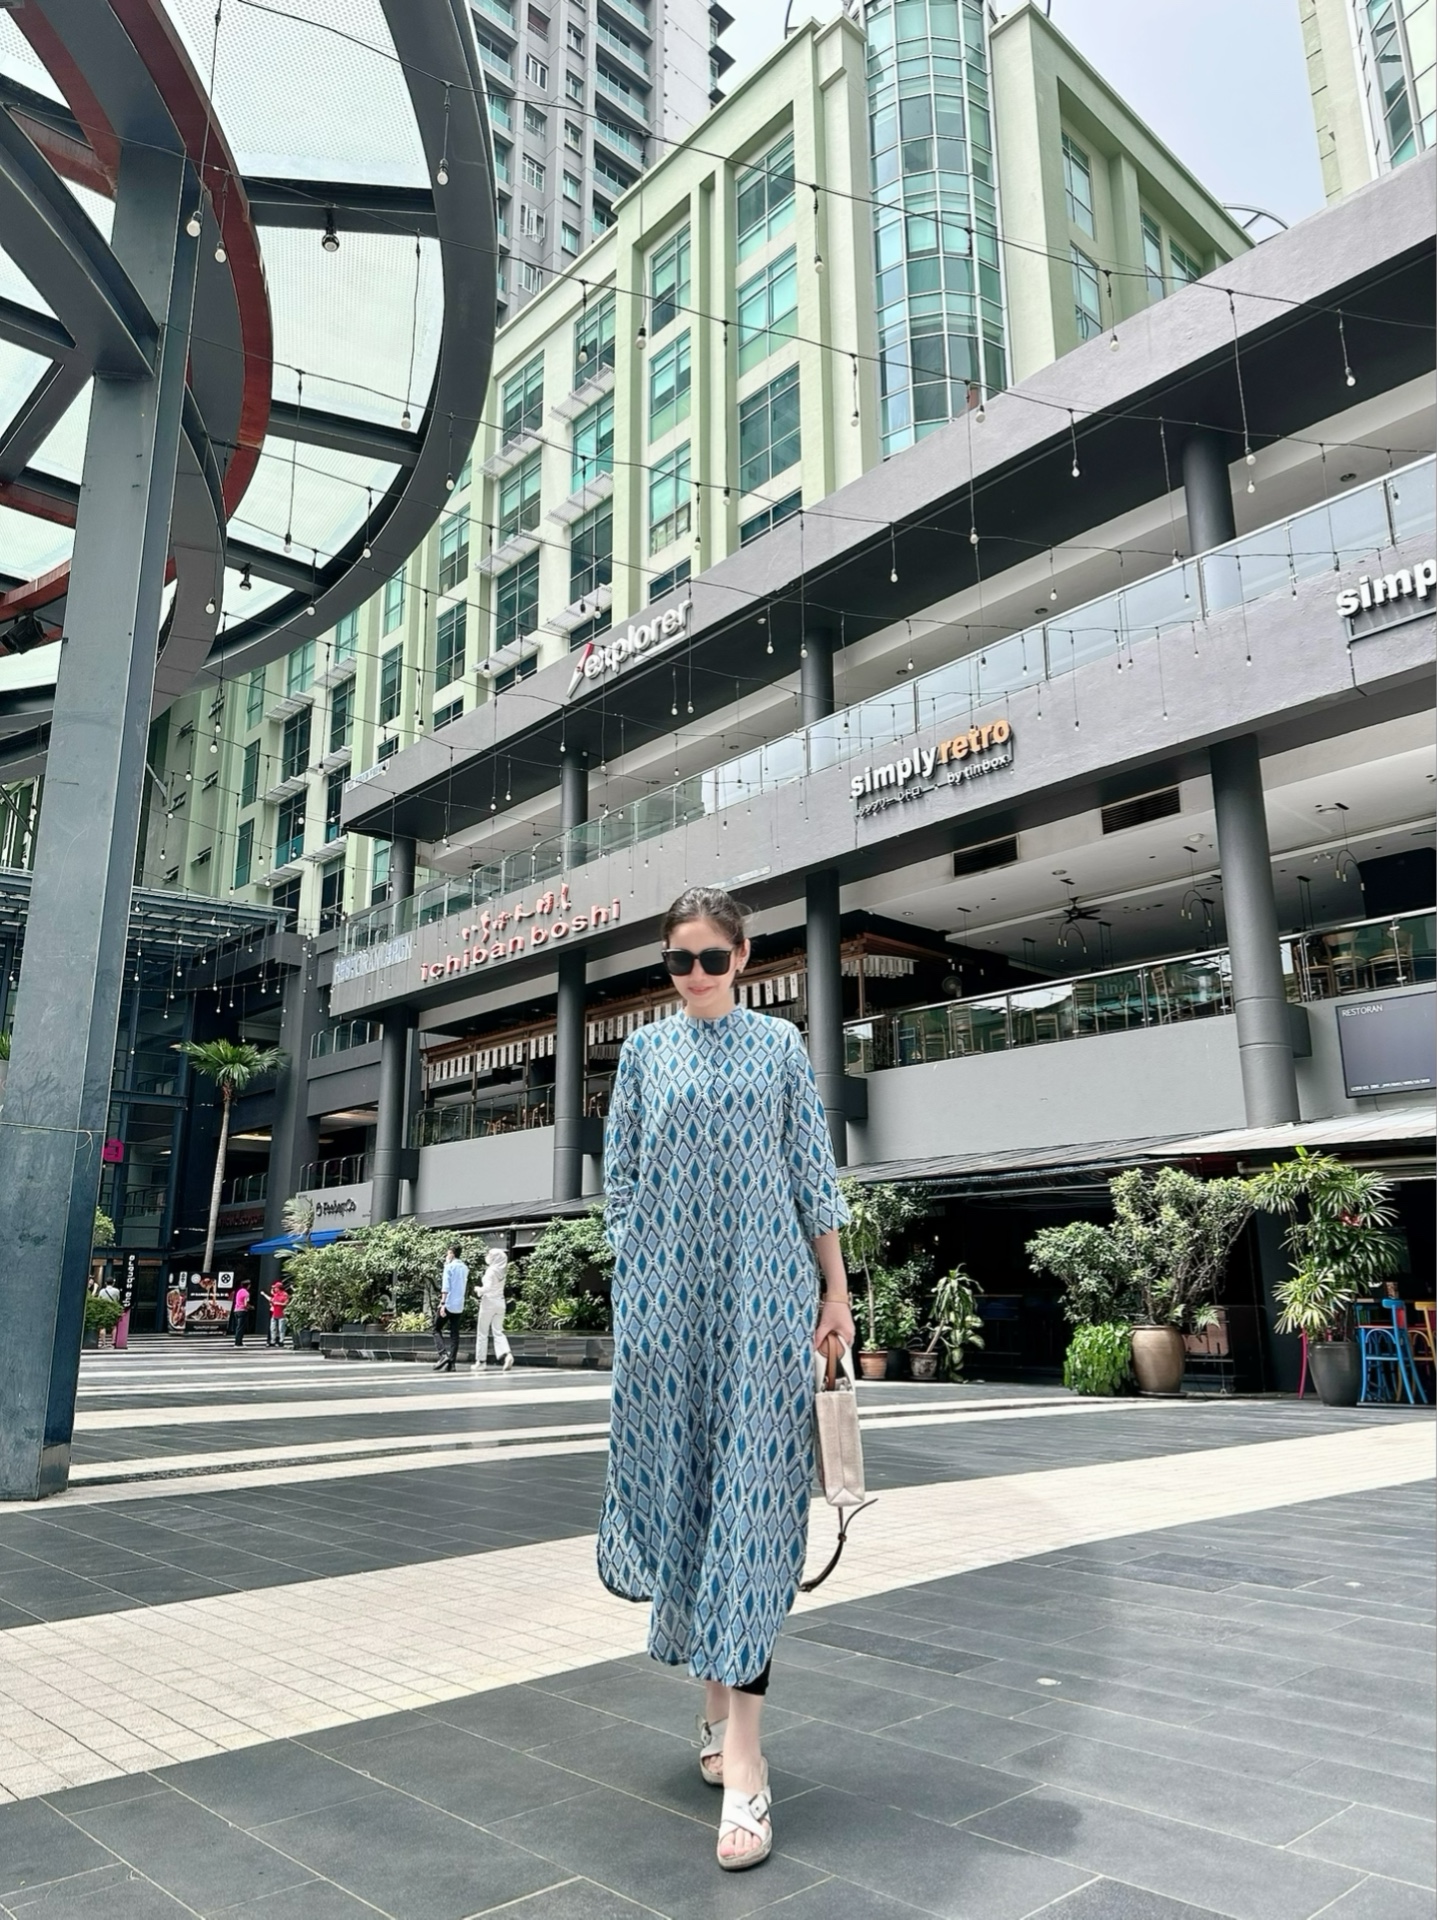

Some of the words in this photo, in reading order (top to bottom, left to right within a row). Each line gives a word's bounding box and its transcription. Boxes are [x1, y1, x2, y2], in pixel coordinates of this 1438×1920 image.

[1336, 558, 1437, 618] simp
[584, 599, 694, 680] explorer
[947, 770, 963, 786] by
[420, 935, 526, 982] ichiban
[530, 897, 621, 947] boshi
[1341, 1004, 1384, 1017] RESTORAN
